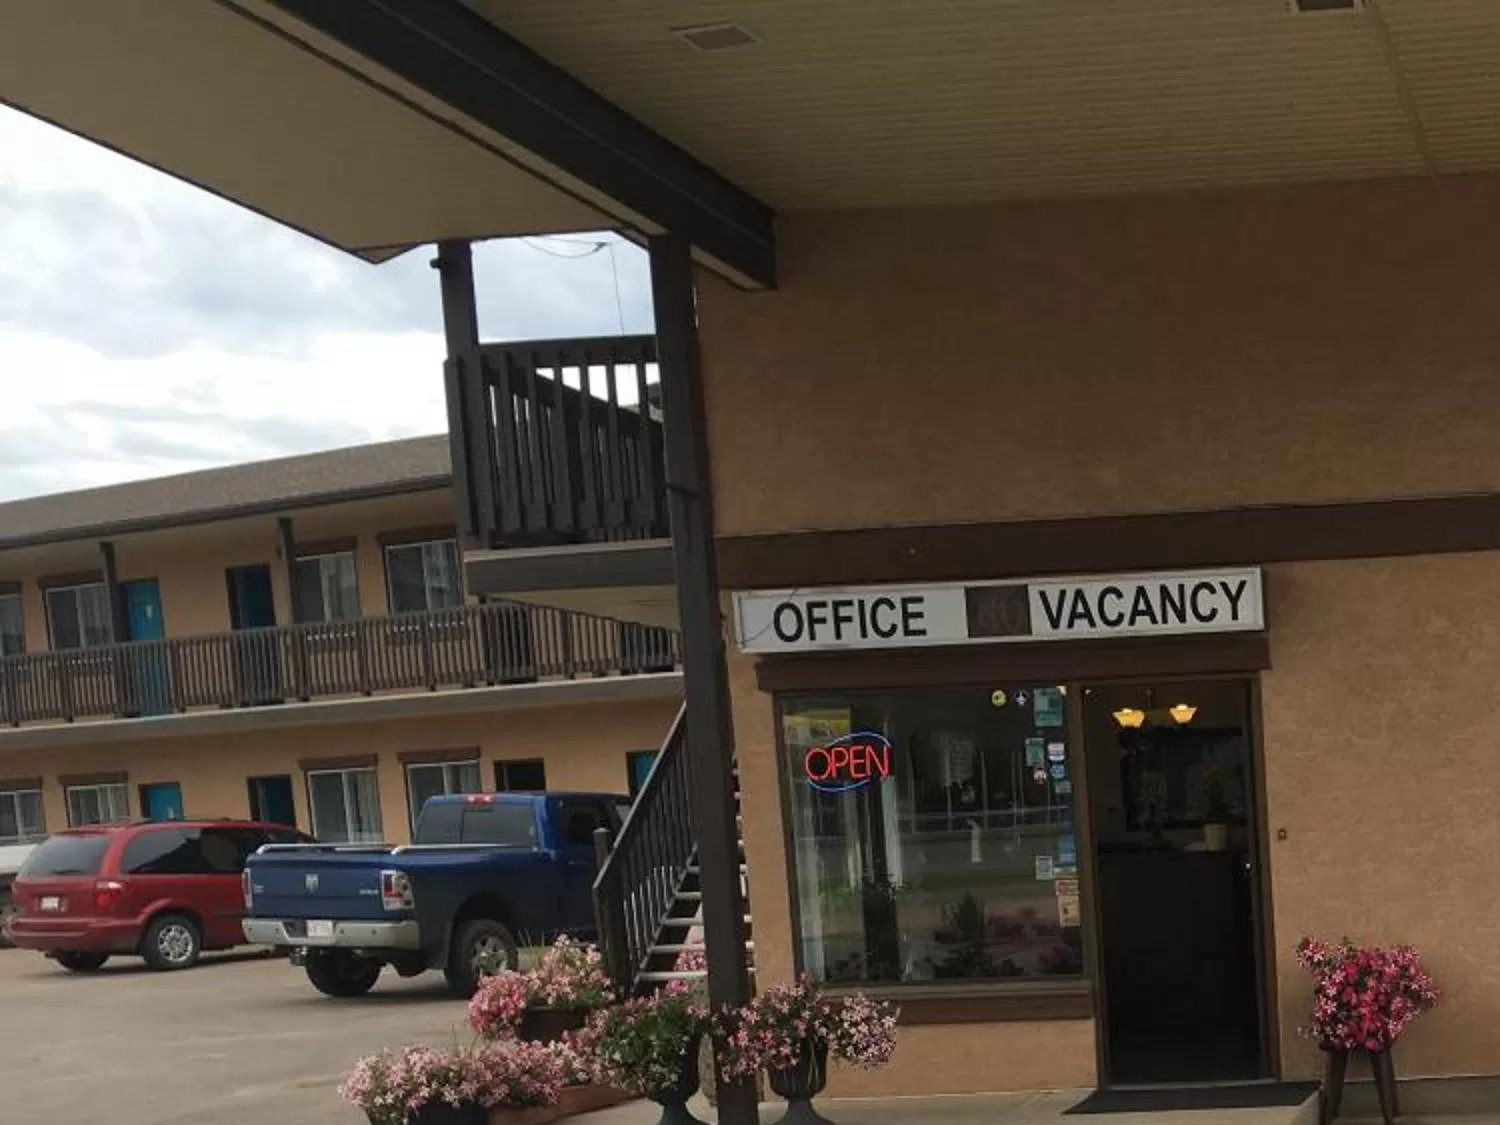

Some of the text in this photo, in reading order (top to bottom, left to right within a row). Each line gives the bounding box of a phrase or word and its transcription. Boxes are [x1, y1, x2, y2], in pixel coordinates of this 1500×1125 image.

[773, 596, 927, 642] OFFICE
[1038, 579, 1248, 630] VACANCY
[804, 744, 891, 781] OPEN
